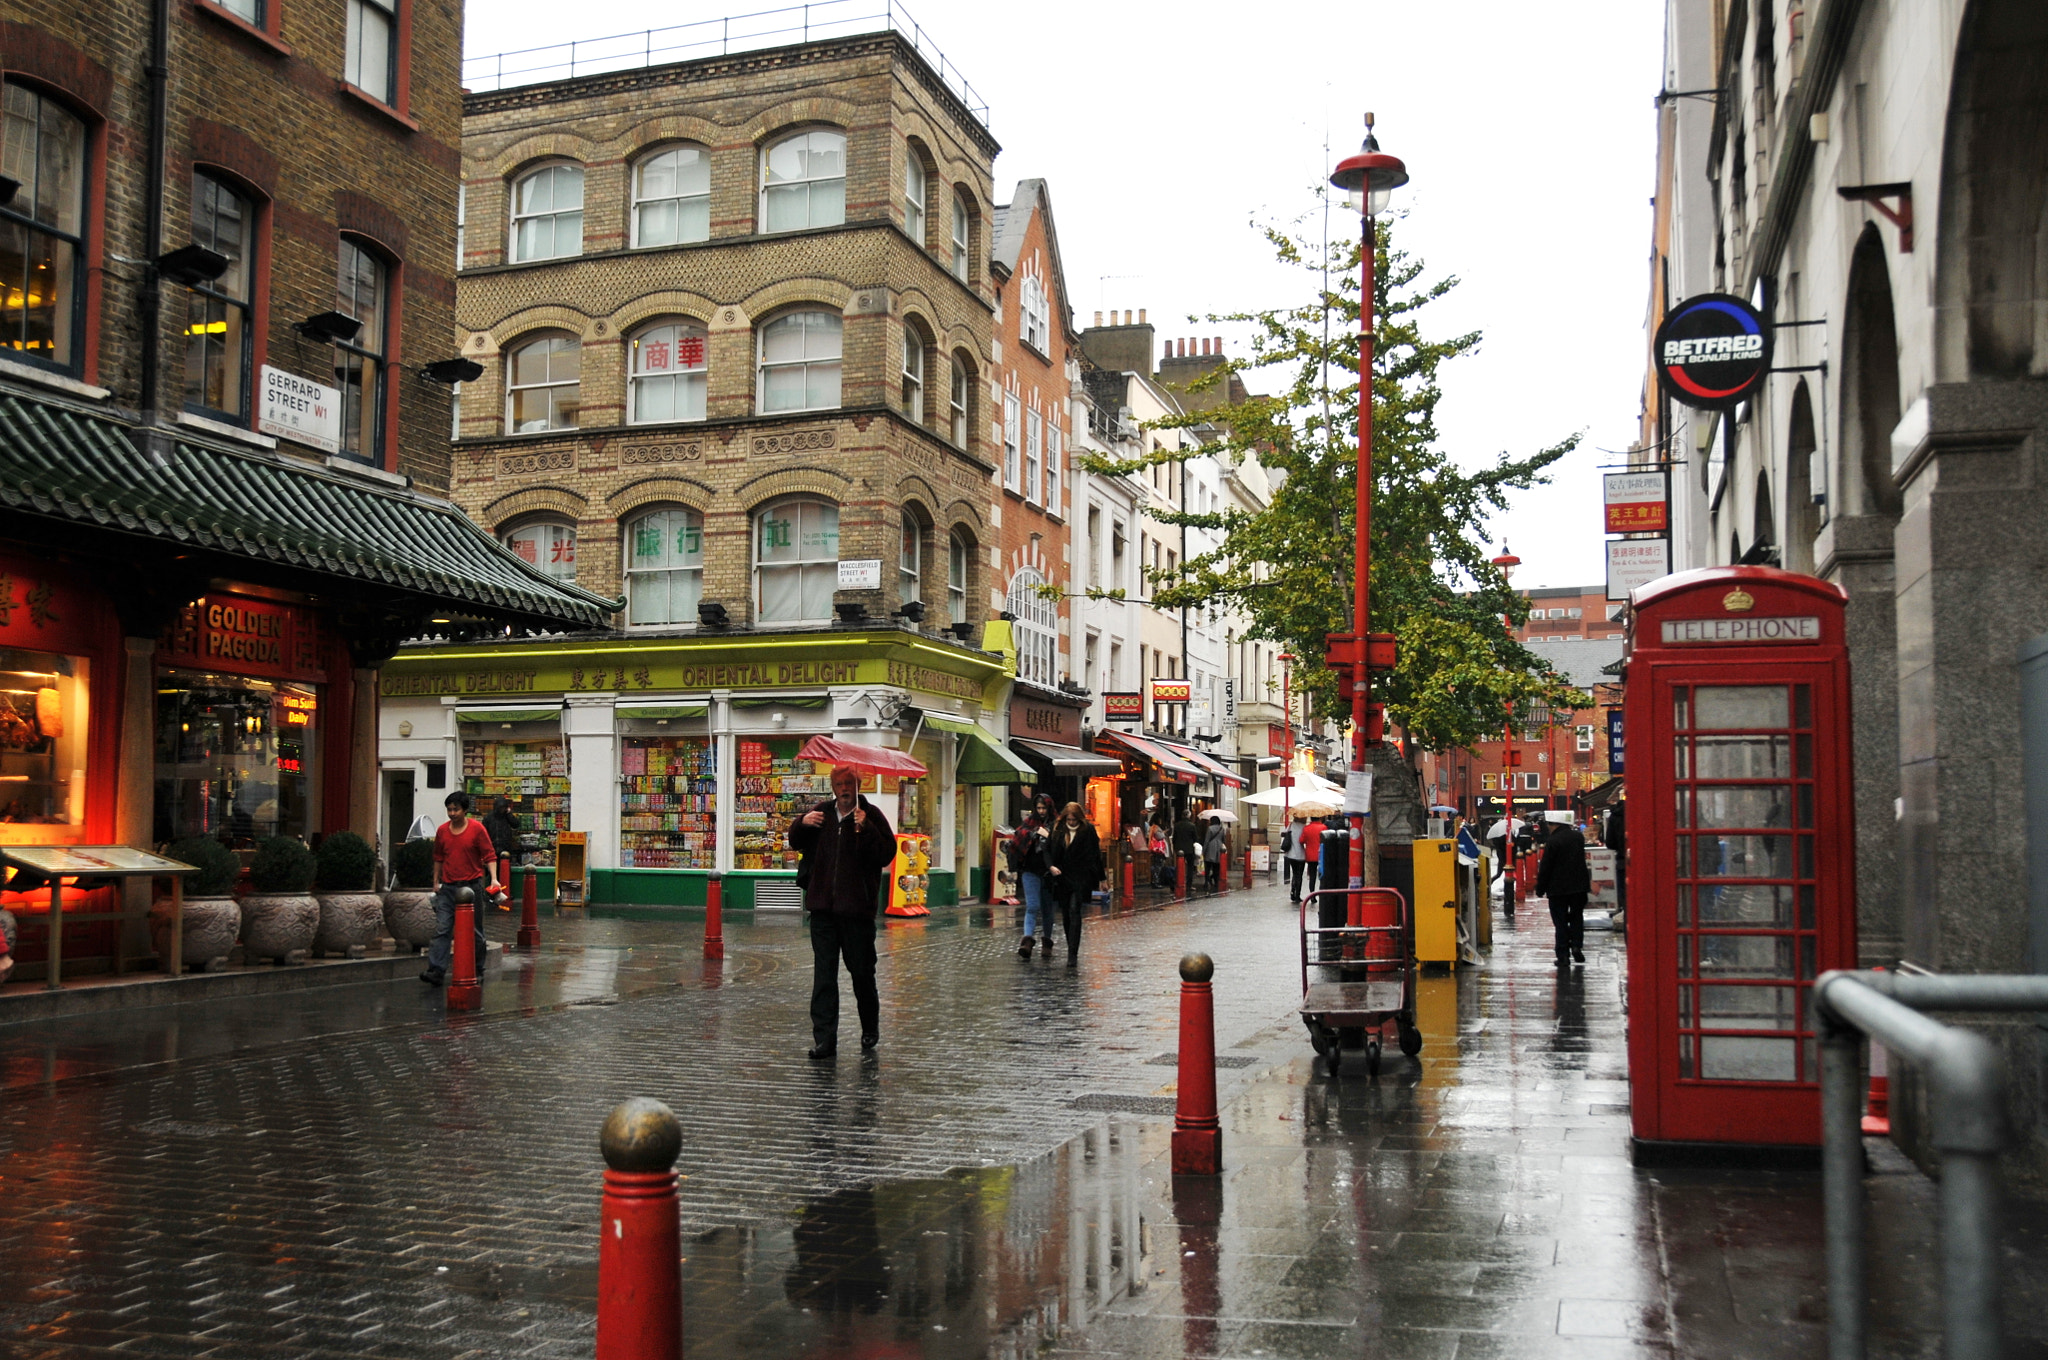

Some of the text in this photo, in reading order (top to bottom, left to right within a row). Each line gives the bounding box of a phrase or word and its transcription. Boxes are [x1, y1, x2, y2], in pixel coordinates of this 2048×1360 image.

[1664, 334, 1763, 357] BETFRED
[1664, 350, 1762, 365] THE BONUS KING
[268, 372, 321, 400] GERRARD
[268, 389, 328, 419] STREET W1
[1609, 506, 1662, 519] 英王會計
[636, 526, 701, 556] 旅行
[208, 604, 282, 638] GOLDEN
[1667, 619, 1813, 641] TELEPHONE
[209, 632, 282, 663] PAGODA
[382, 671, 536, 695] ORIENTAL DELIGHT
[571, 666, 653, 690] 東方美味
[682, 661, 859, 686] ORIENTAL DELIGHT
[1225, 680, 1233, 698] TOP
[283, 696, 317, 709] Dim Sum
[288, 711, 309, 726] Daily
